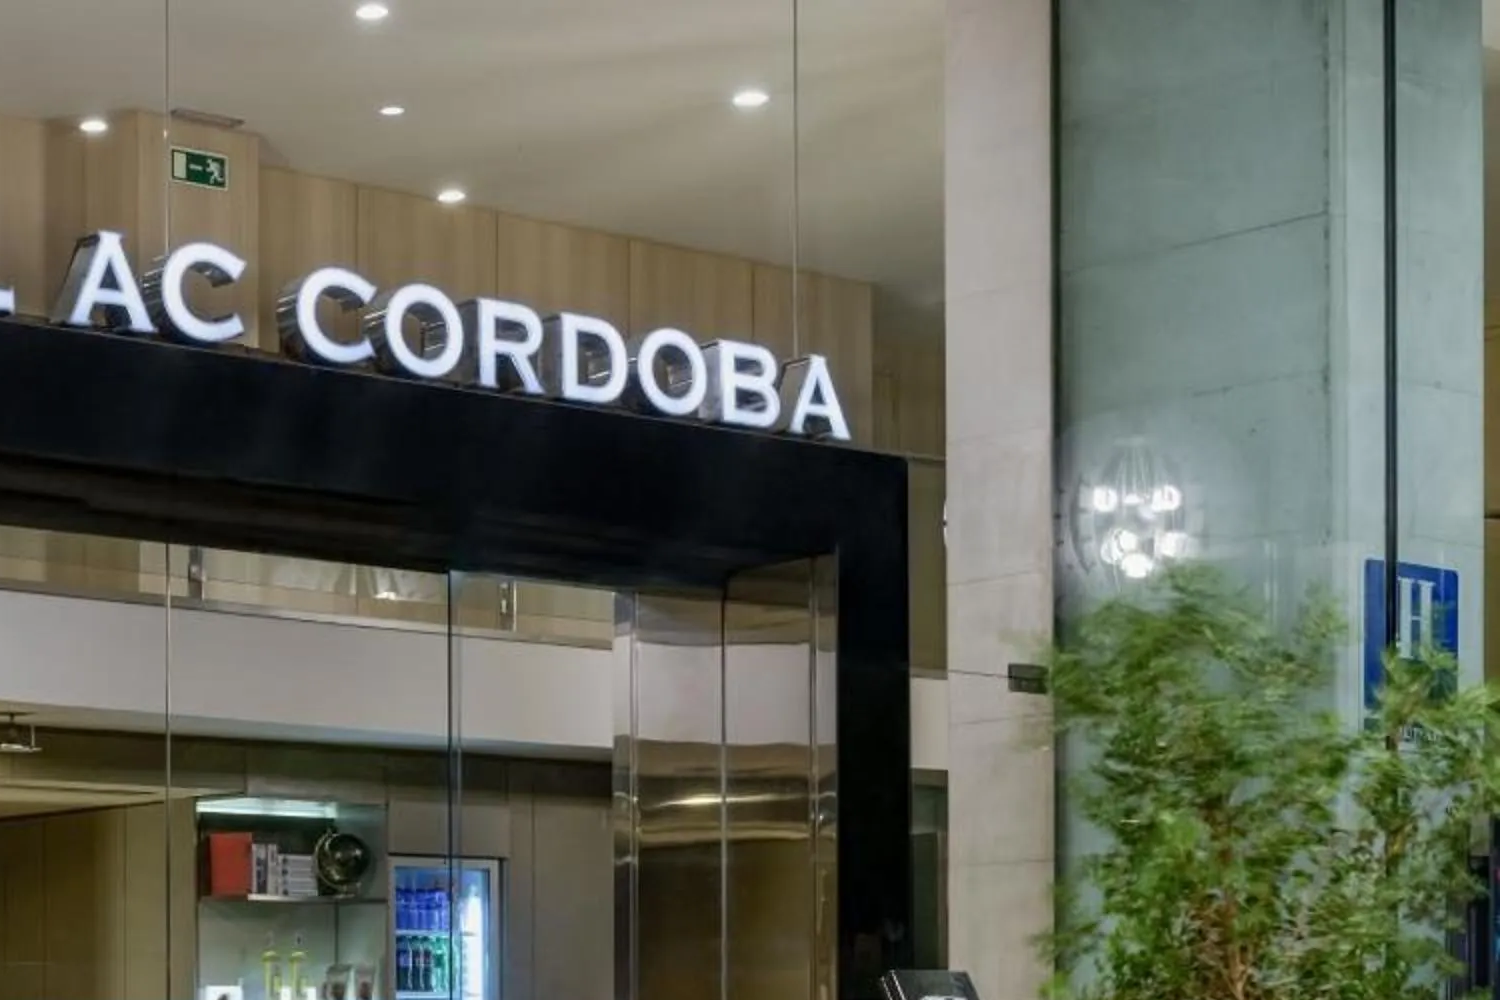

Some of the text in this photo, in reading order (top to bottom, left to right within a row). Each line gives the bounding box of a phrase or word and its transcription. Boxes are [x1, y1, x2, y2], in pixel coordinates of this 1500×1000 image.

[67, 229, 247, 344] AC
[292, 265, 852, 441] CORDOBA
[1396, 576, 1436, 661] H
